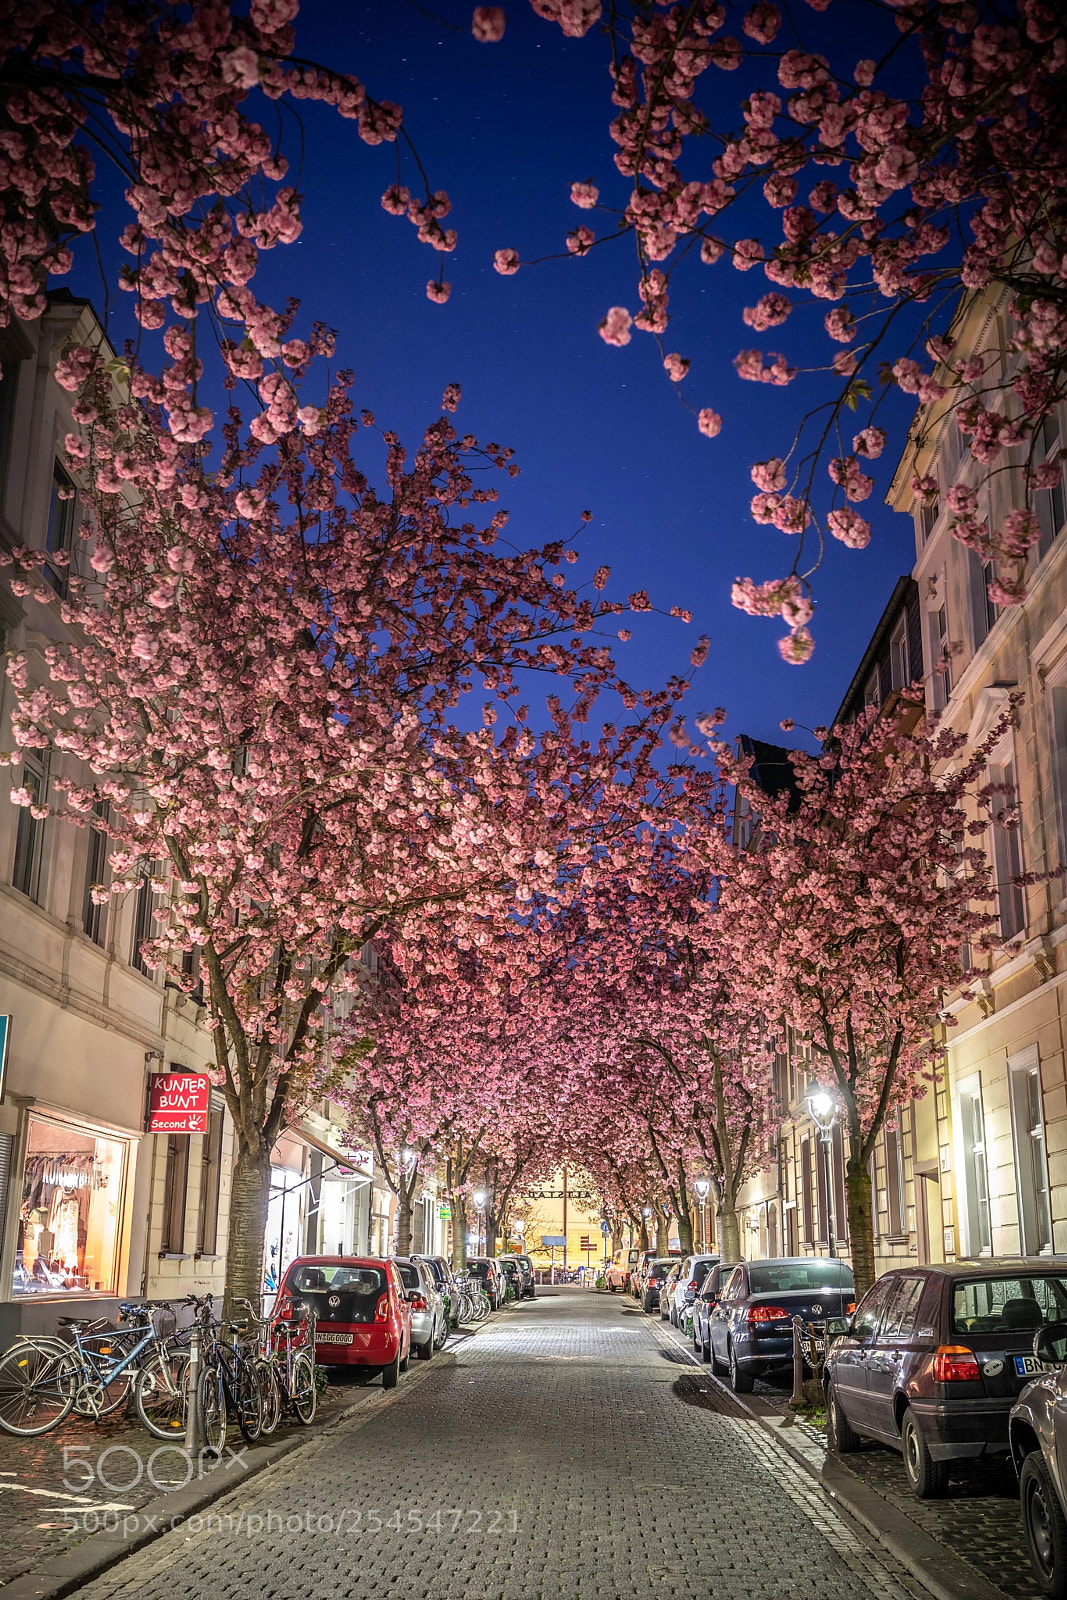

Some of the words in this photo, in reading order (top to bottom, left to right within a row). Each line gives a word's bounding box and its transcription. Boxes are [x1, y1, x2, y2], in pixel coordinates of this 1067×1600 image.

[154, 1077, 206, 1093] KUNTER
[160, 1094, 199, 1109] BUNT
[151, 1119, 187, 1129] Second
[1024, 1358, 1044, 1373] BN
